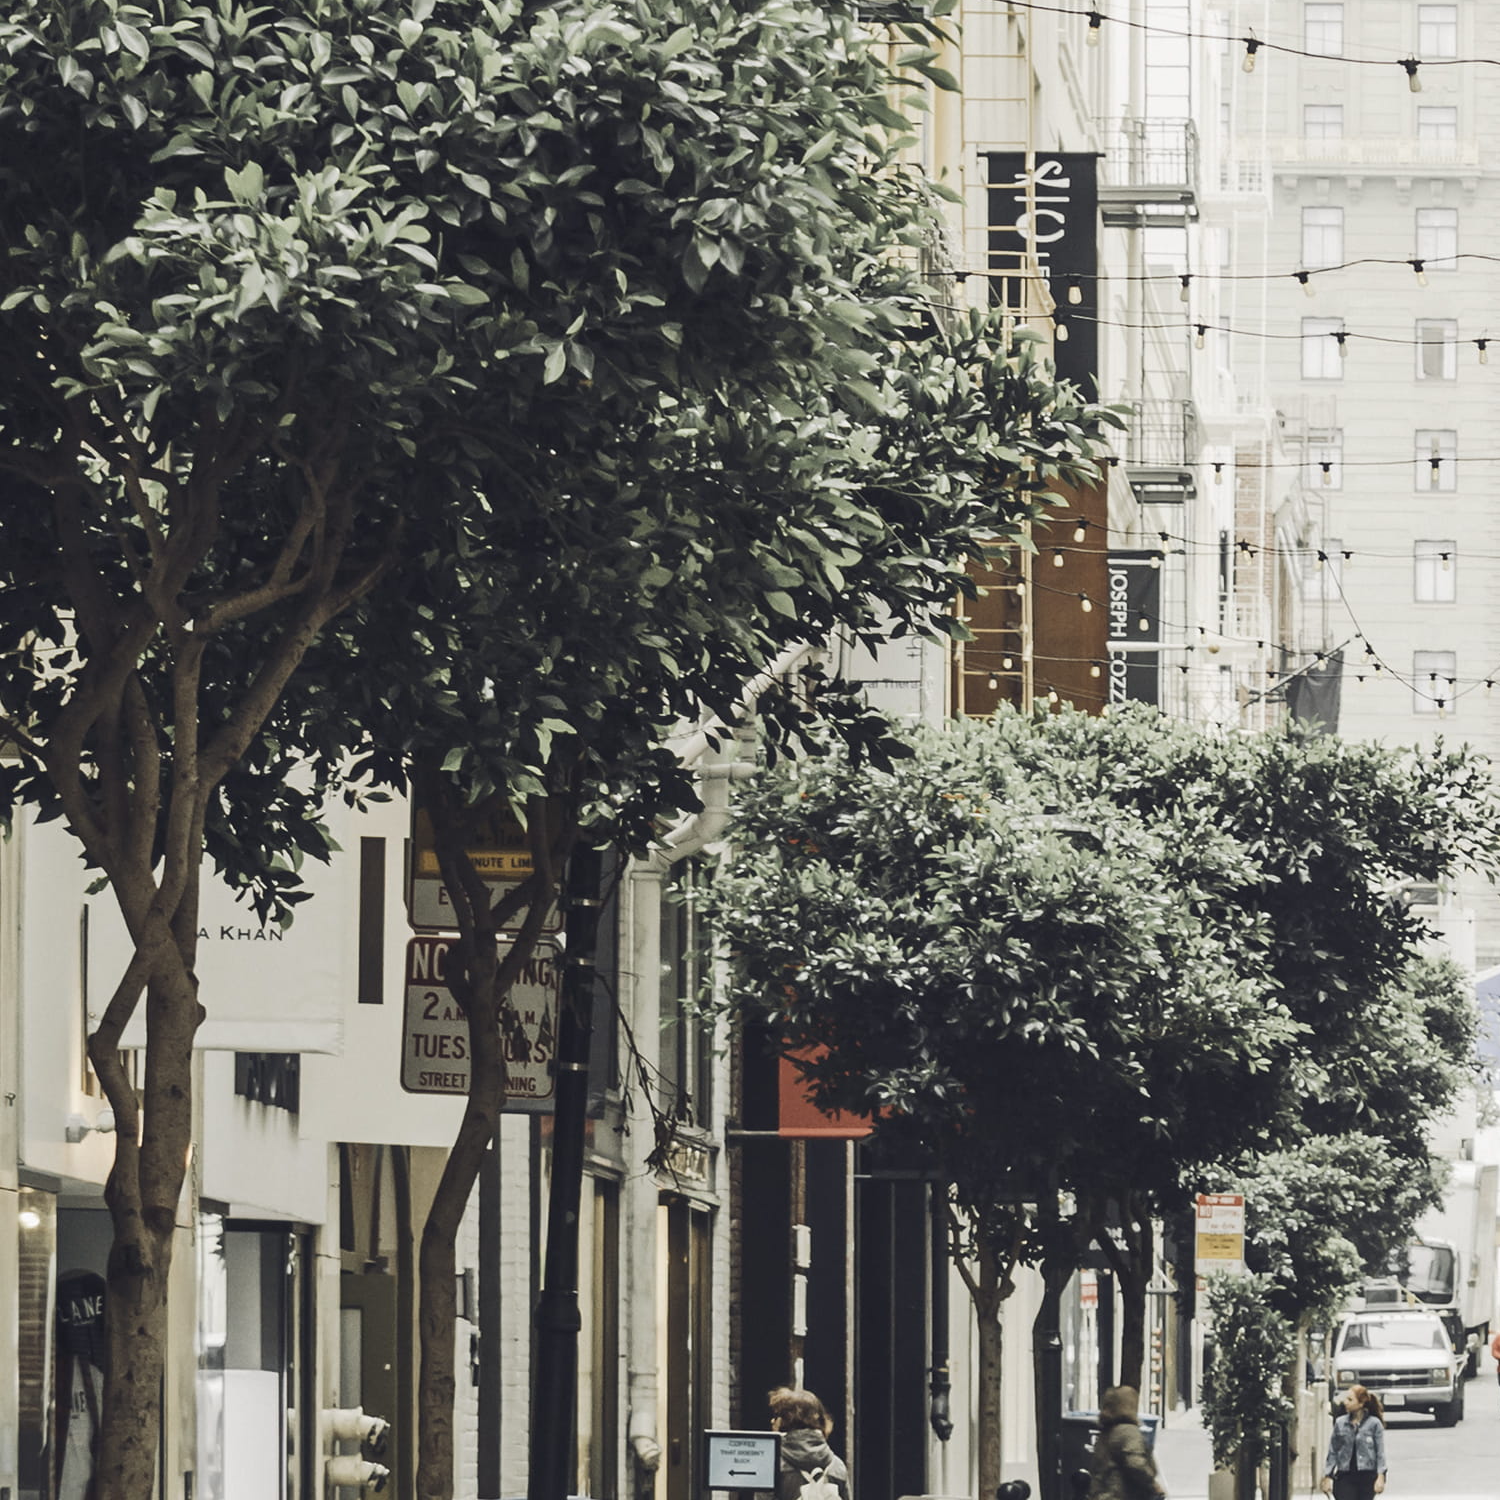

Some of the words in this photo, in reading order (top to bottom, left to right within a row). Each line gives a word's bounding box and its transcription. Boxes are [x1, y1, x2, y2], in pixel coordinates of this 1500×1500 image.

[1108, 568, 1128, 638] JOSEPH
[423, 991, 440, 1021] 2
[412, 1033, 471, 1060] TUES.
[419, 1071, 467, 1088] STREET
